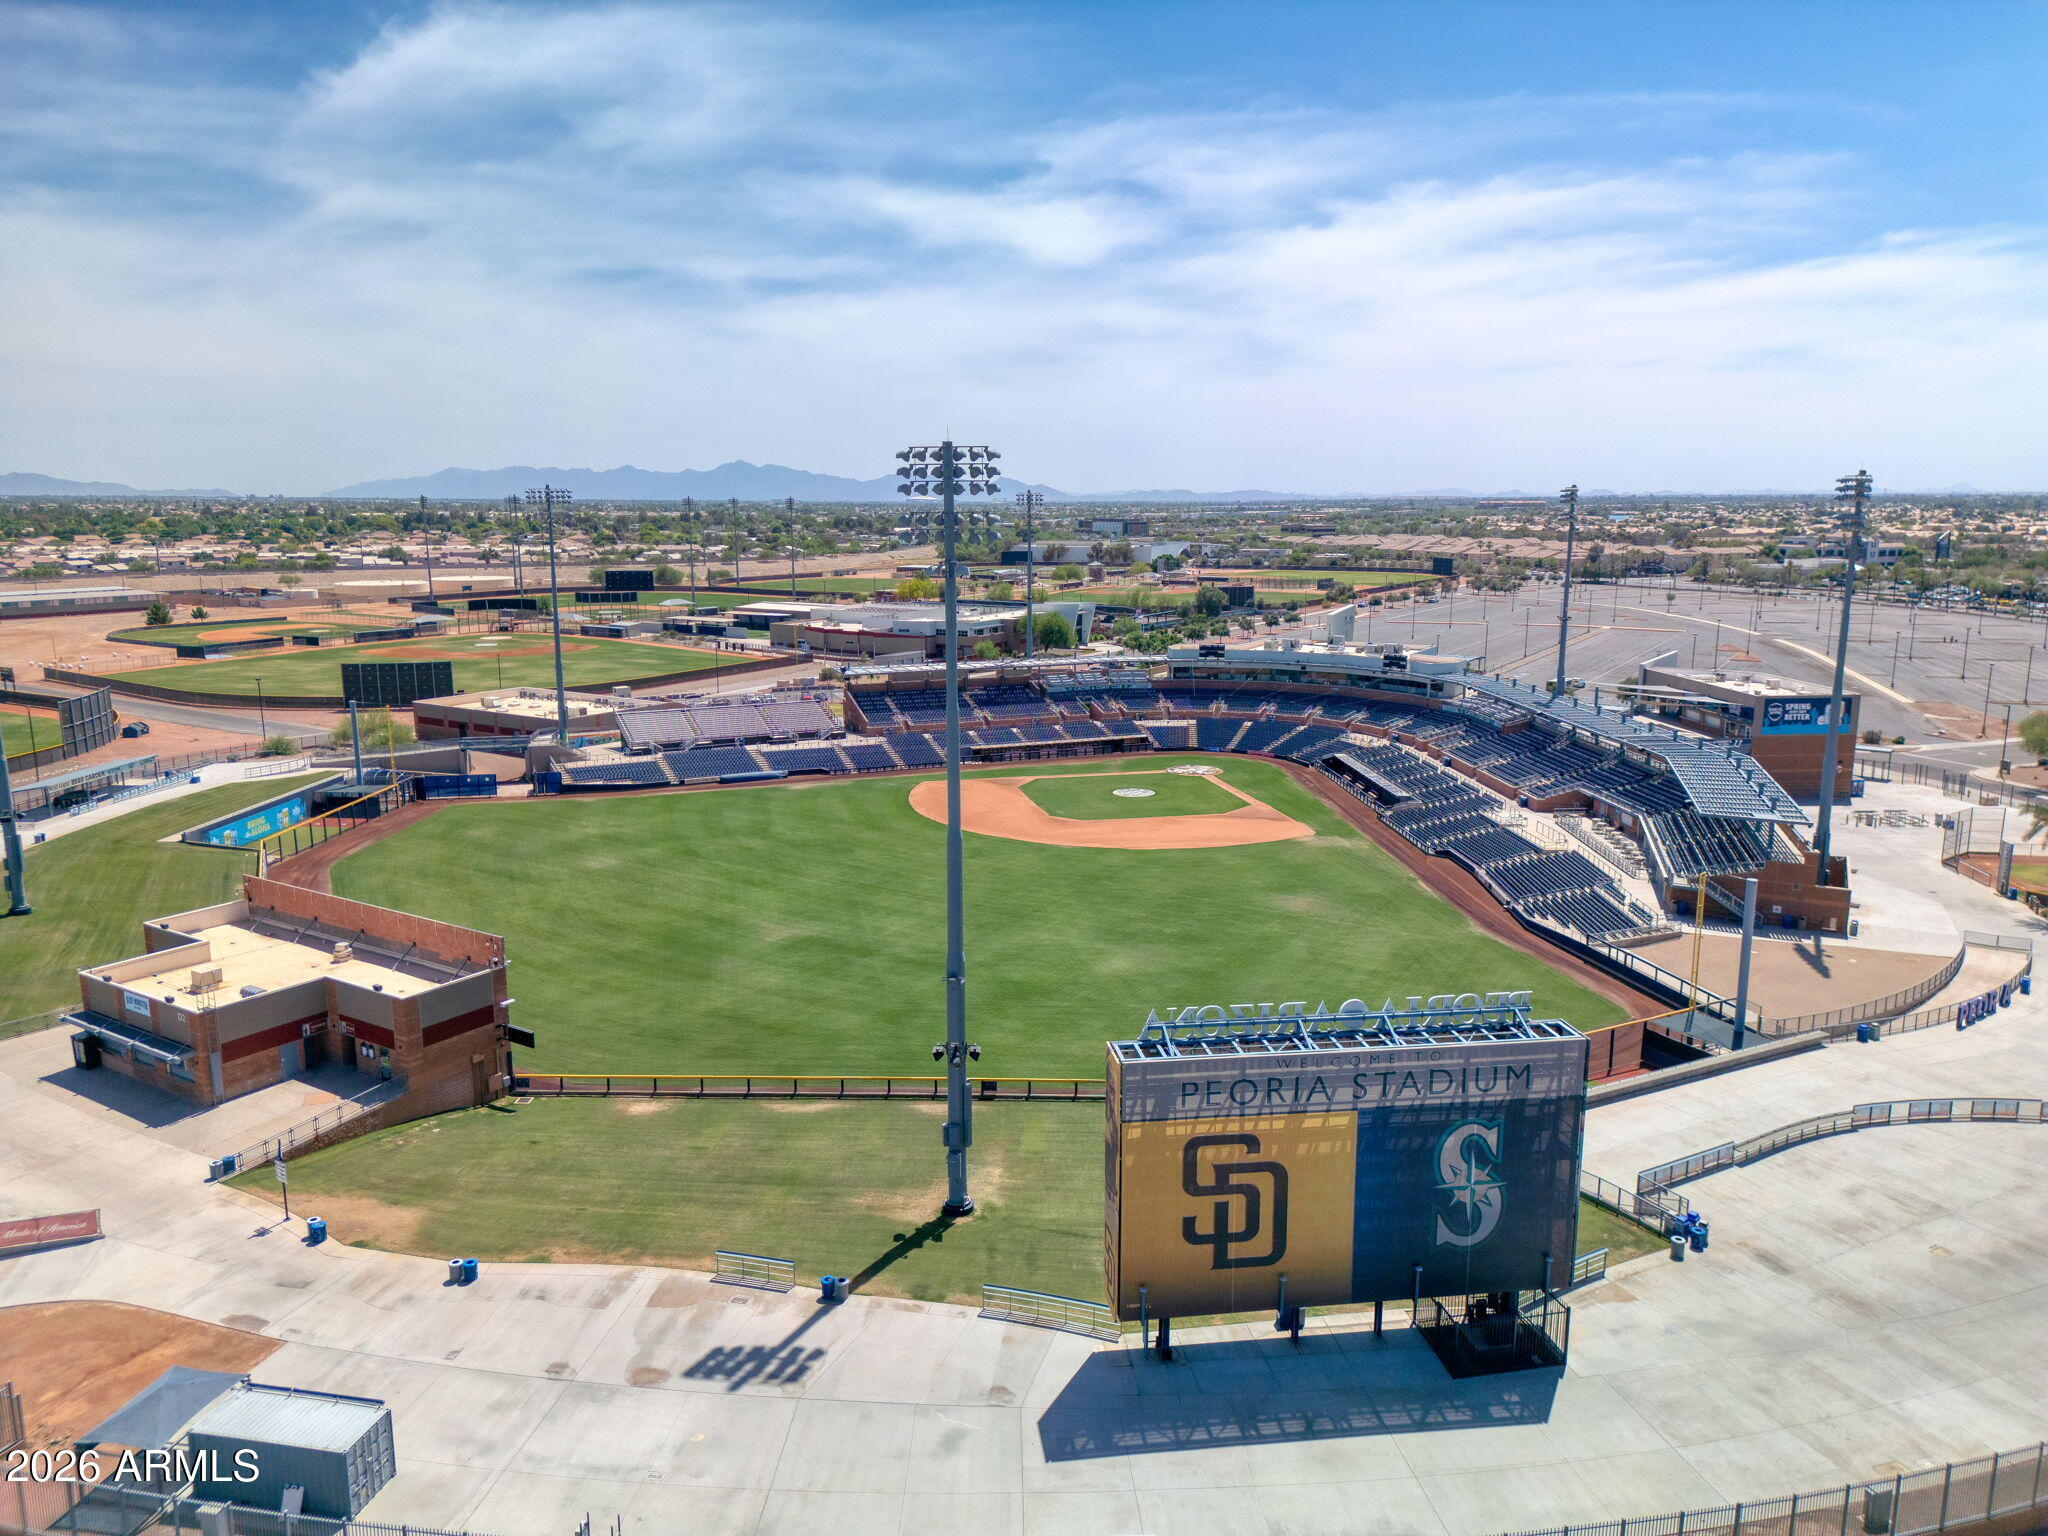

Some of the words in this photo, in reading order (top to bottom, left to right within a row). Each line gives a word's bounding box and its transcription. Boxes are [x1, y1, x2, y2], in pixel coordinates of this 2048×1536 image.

[1784, 702, 1812, 711] SPRING
[1784, 713, 1810, 721] BETTER
[71, 776, 85, 786] BEER
[85, 770, 105, 784] GARDEN
[1956, 983, 2012, 1032] PEORA
[1276, 1053, 1397, 1068] WELCOME
[1415, 1050, 1443, 1063] TO
[1181, 1075, 1331, 1108] PEORIA
[1352, 1063, 1532, 1100] STADIUM
